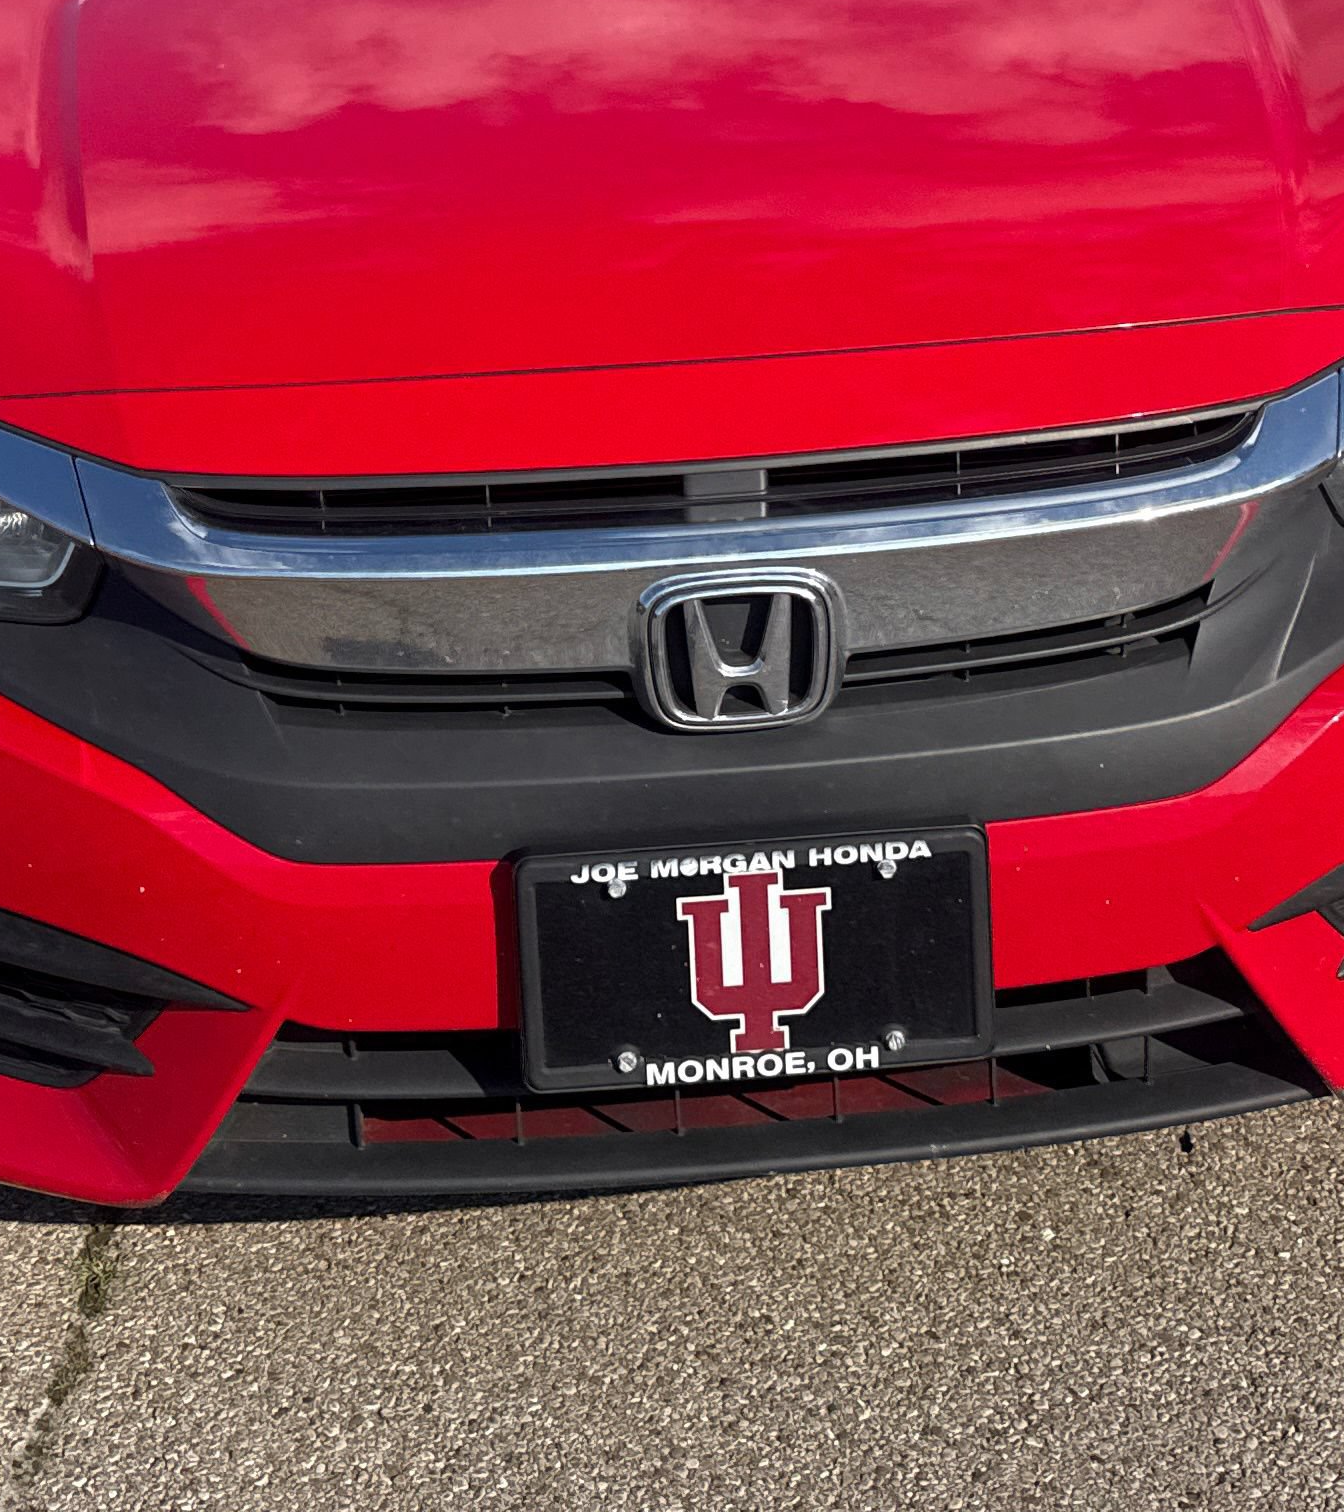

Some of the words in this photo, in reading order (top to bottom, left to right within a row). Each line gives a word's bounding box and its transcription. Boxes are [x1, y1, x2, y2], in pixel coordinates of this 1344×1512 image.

[570, 859, 639, 884] JOE
[650, 850, 795, 880] MORGAN
[809, 840, 932, 869] HONDA
[645, 1051, 815, 1086] MONROE,
[827, 1045, 880, 1071] OH
